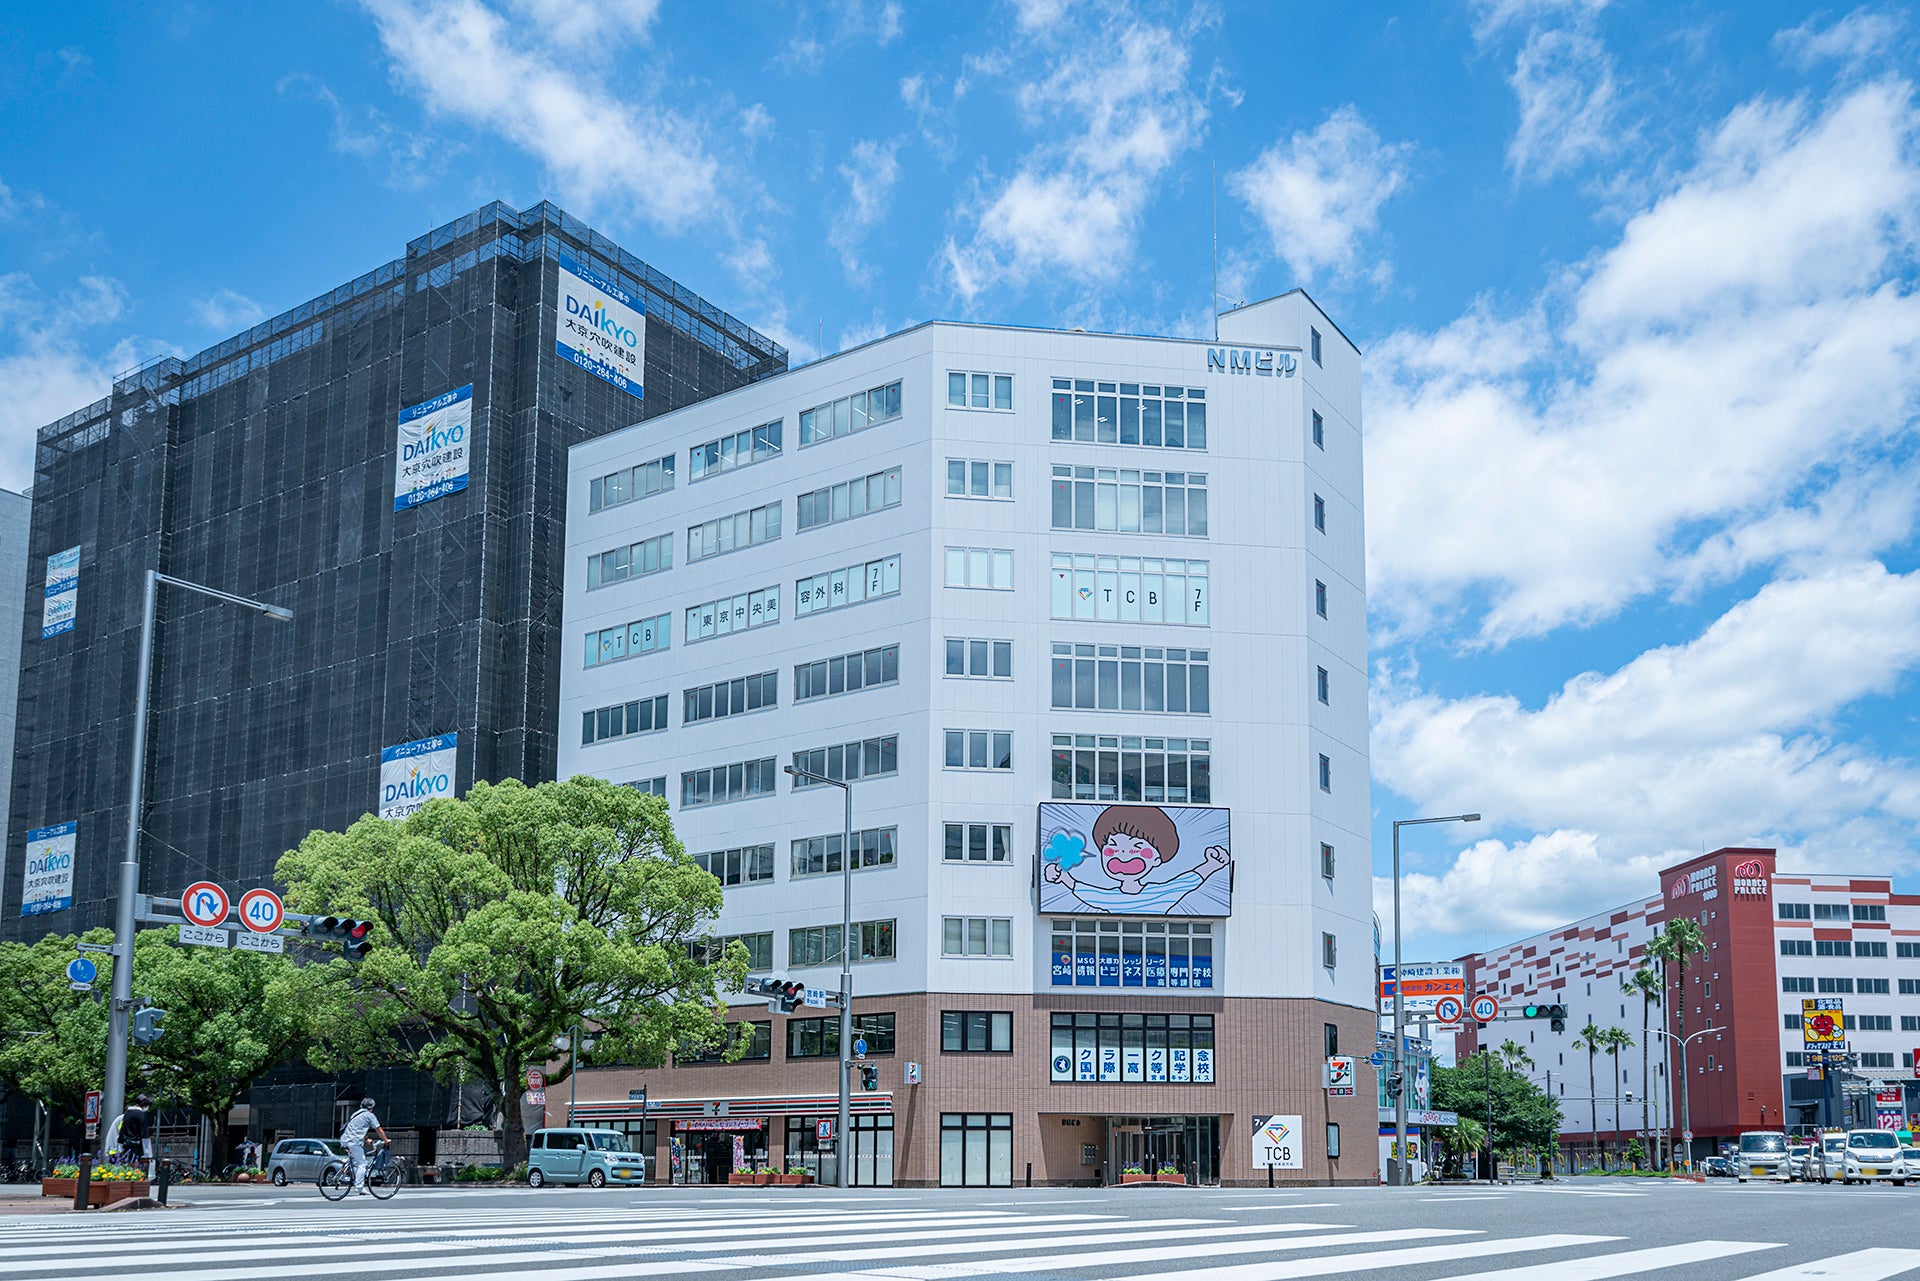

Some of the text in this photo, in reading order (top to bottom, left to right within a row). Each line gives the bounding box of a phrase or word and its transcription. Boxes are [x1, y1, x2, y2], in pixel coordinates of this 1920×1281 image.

[565, 318, 637, 366] 大京穴吹建設
[1207, 348, 1297, 373] NMビル
[402, 447, 463, 478] 大京穴吹建設
[1104, 588, 1158, 605] TCB
[616, 629, 652, 648] TCB
[1734, 886, 1767, 895] PALACE
[249, 901, 274, 921] 40
[183, 929, 225, 943] ここから
[240, 936, 280, 949] ここから
[1425, 982, 1460, 992] カンエイ
[1477, 1001, 1493, 1015] 40
[1081, 1049, 1209, 1062] クラーク記念
[1080, 1061, 1210, 1074] 国際高等学校
[1264, 1146, 1291, 1161] TCB
